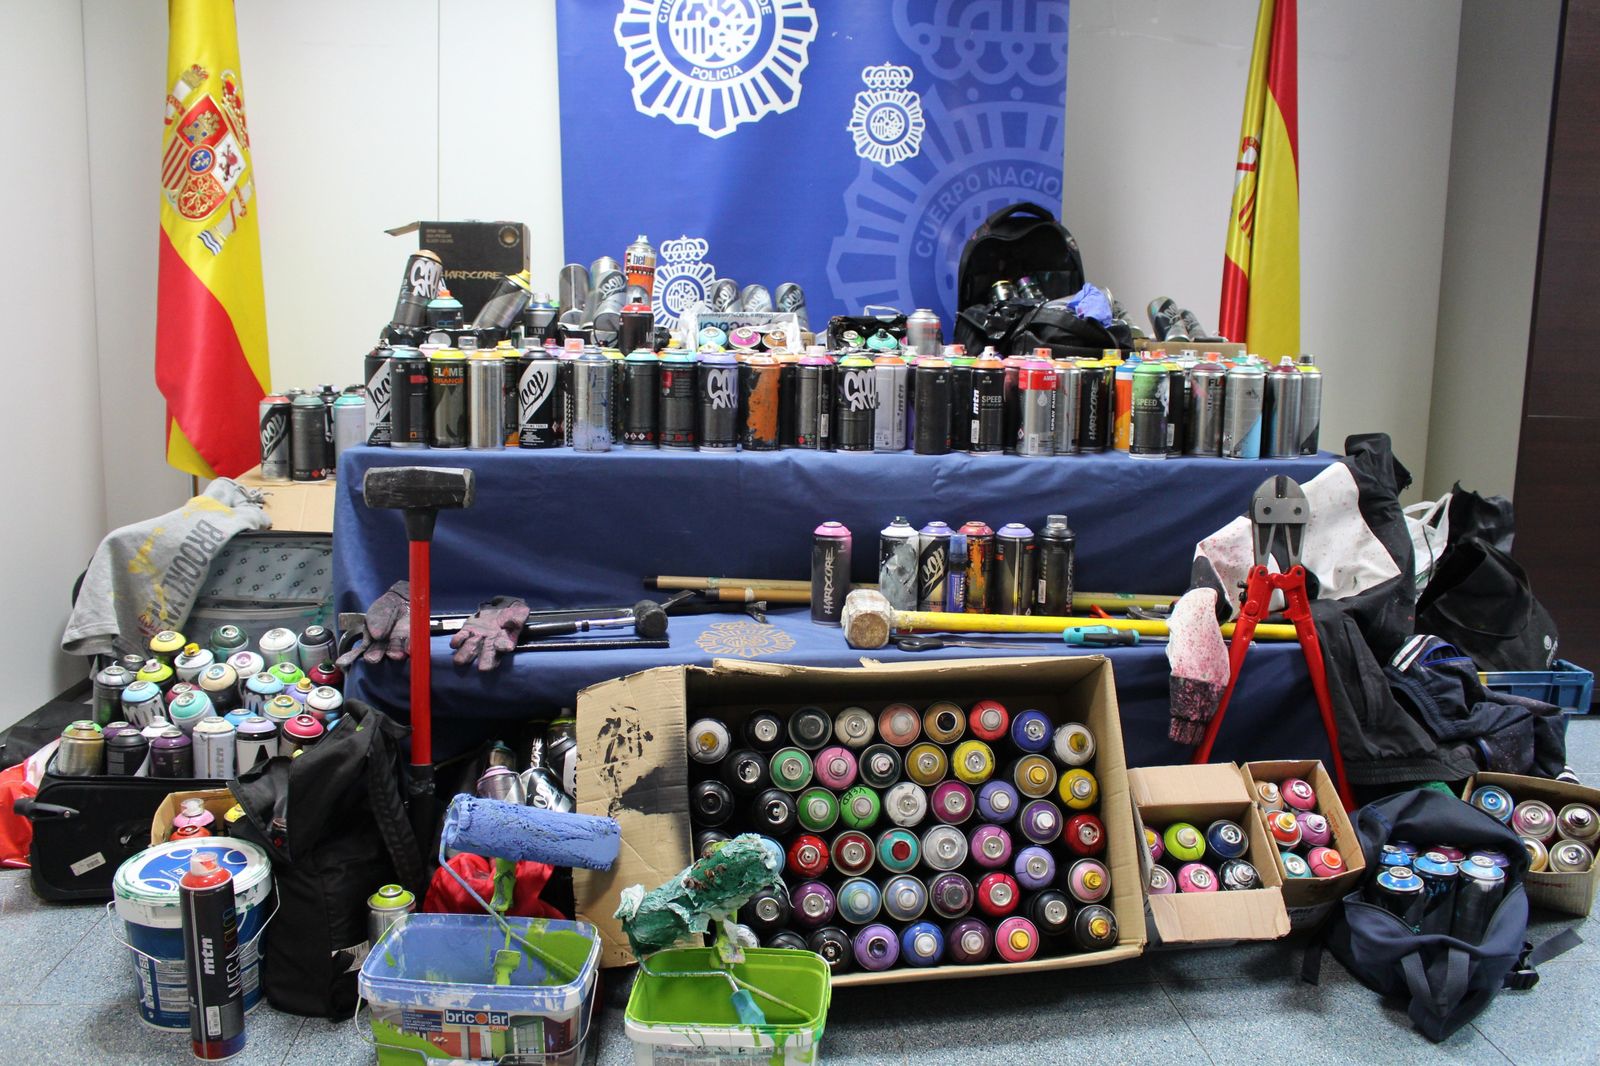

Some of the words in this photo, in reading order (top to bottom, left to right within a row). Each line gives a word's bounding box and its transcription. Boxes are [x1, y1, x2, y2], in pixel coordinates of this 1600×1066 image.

[690, 65, 743, 81] POLICIA
[915, 173, 981, 258] CUERPO
[972, 388, 980, 415] mtn
[981, 395, 1003, 403] SPEED
[151, 519, 226, 627] BROOKLYN
[823, 546, 835, 615] HARDCORE
[201, 937, 216, 976] mtn
[225, 945, 242, 998] MEGA
